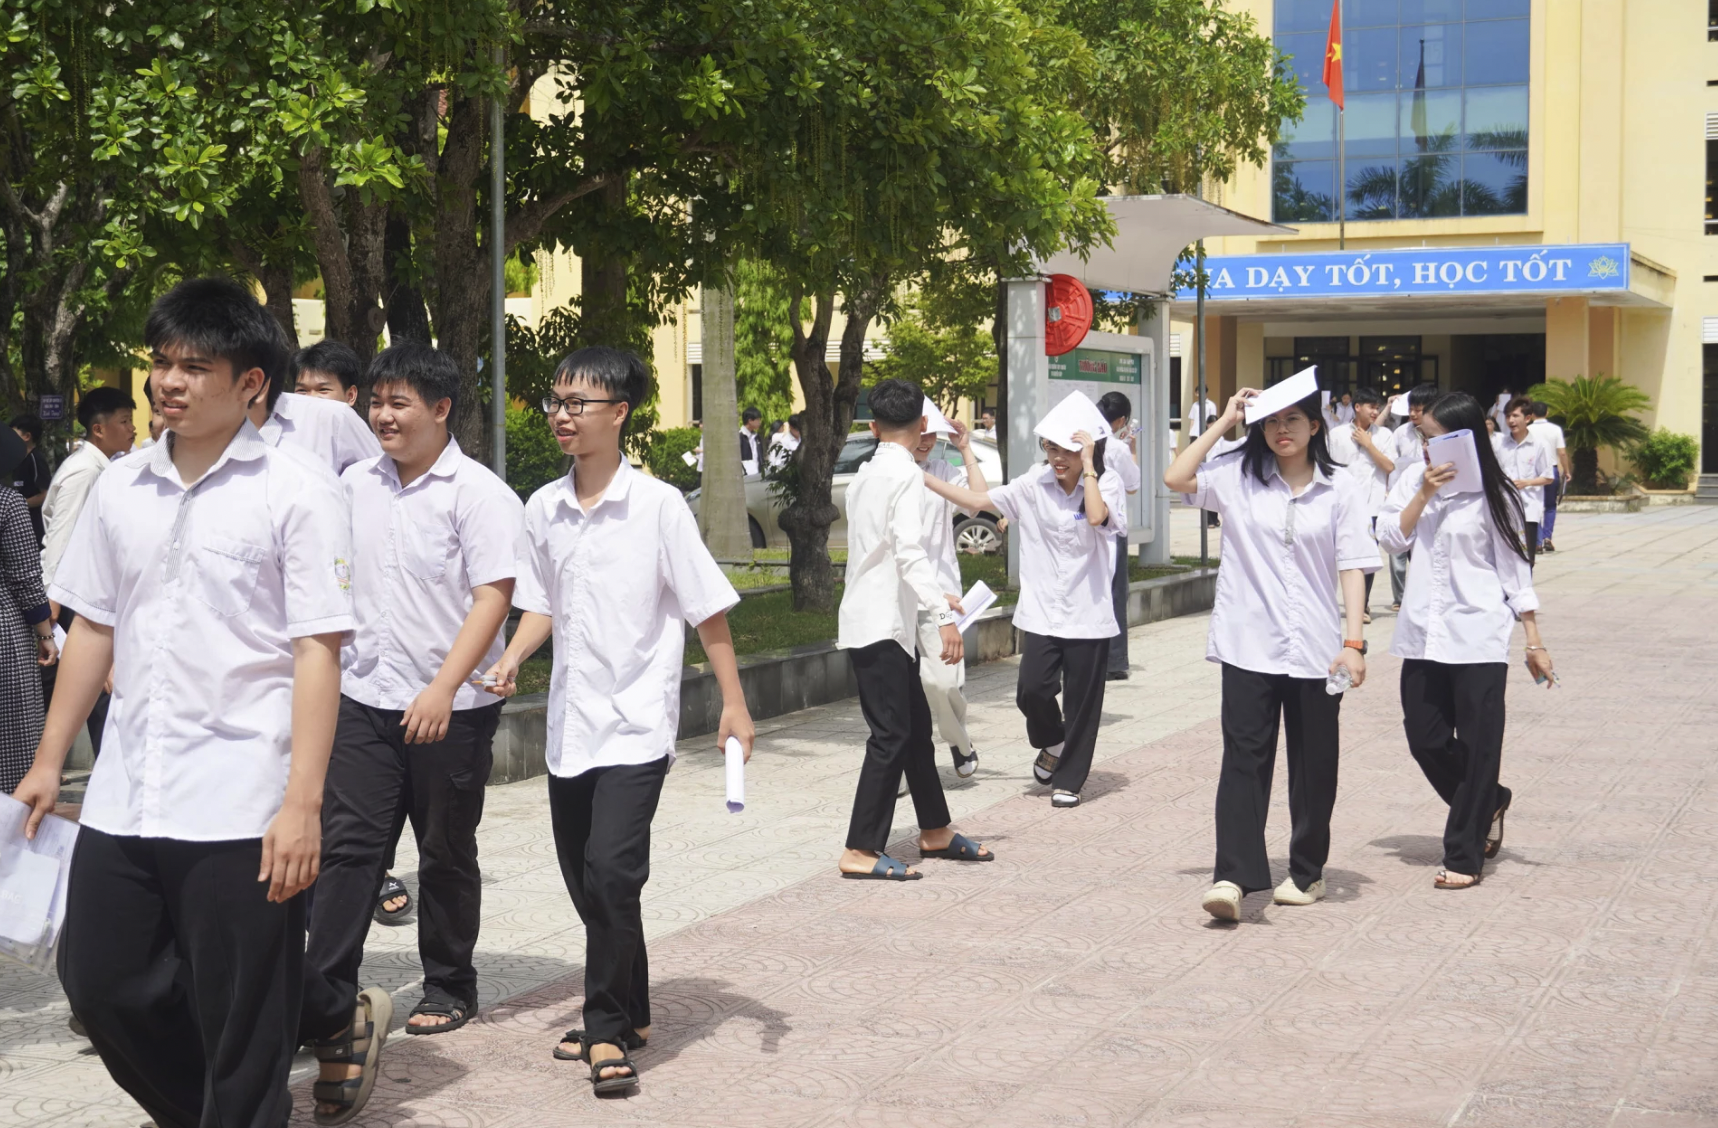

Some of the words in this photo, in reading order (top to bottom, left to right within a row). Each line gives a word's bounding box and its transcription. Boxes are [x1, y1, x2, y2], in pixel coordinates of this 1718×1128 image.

[1245, 265, 1316, 293] DẠY
[1325, 254, 1402, 289] TỐT,
[1412, 260, 1488, 289] HỌC
[1499, 249, 1572, 282] TỐT
